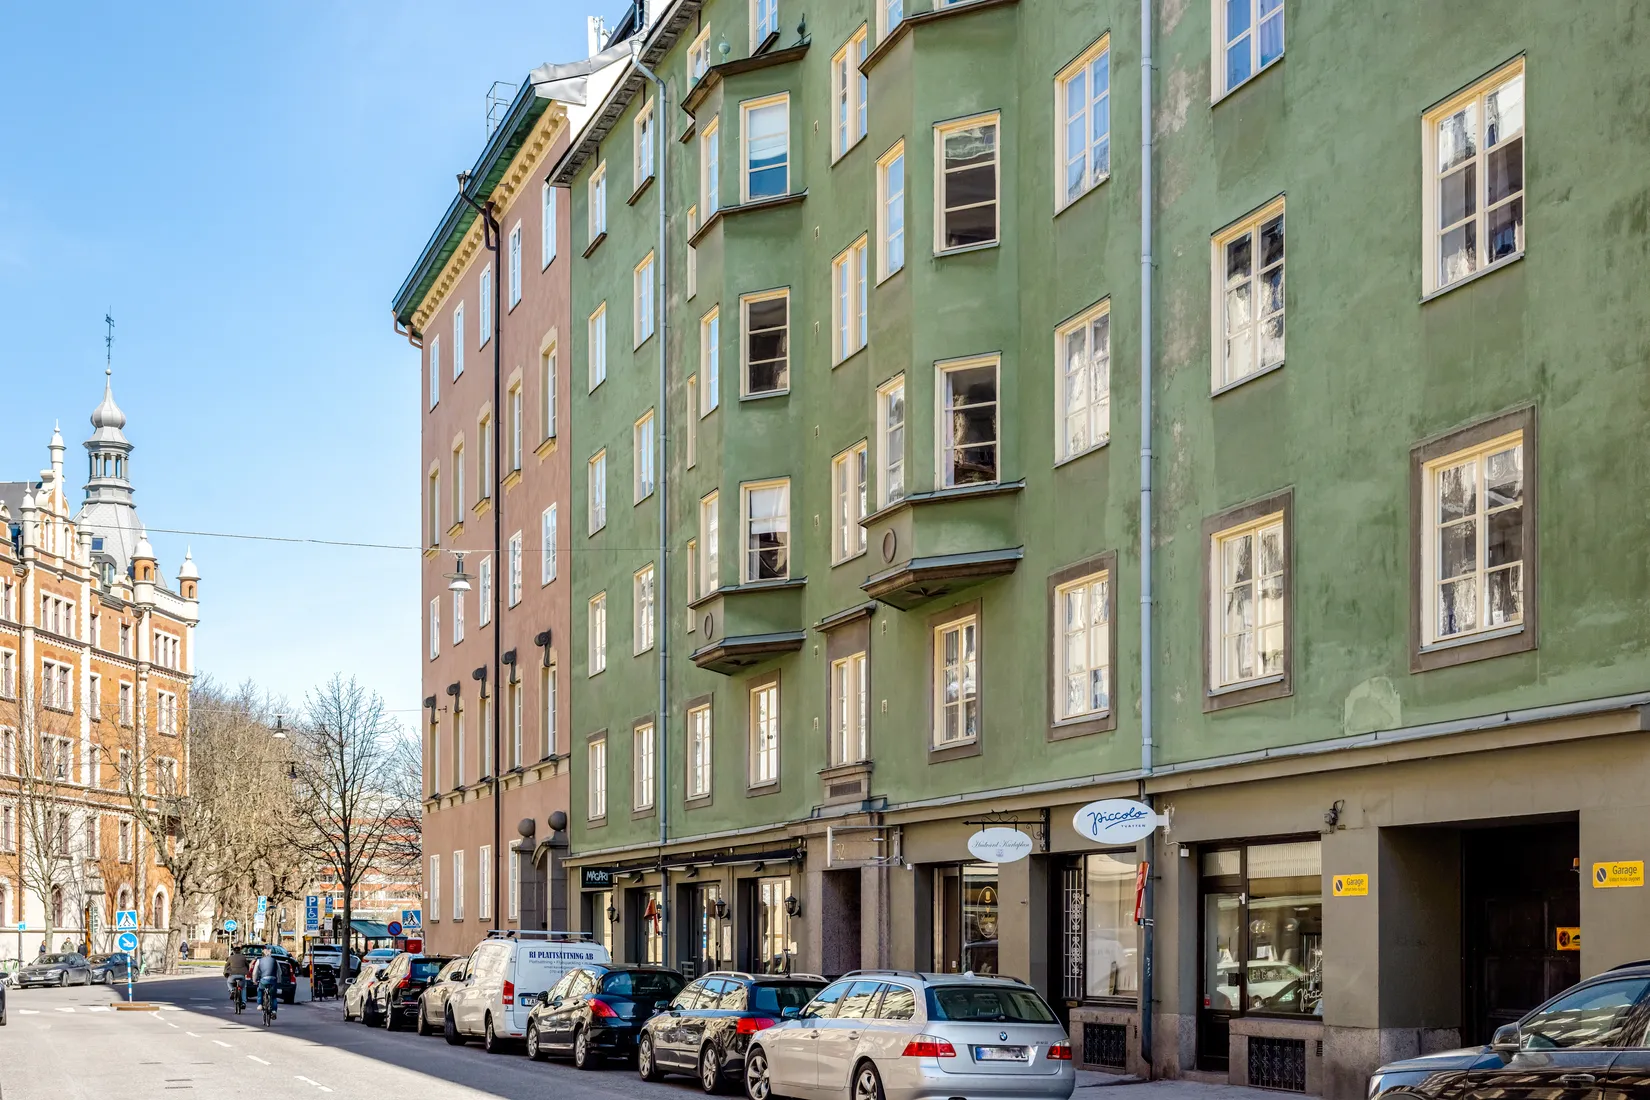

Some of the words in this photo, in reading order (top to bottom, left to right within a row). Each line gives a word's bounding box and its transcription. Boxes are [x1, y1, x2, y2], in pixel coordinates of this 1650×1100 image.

[1612, 865, 1638, 876] Garage
[1346, 877, 1364, 887] Garage
[309, 896, 316, 906] P
[585, 952, 594, 960] AB
